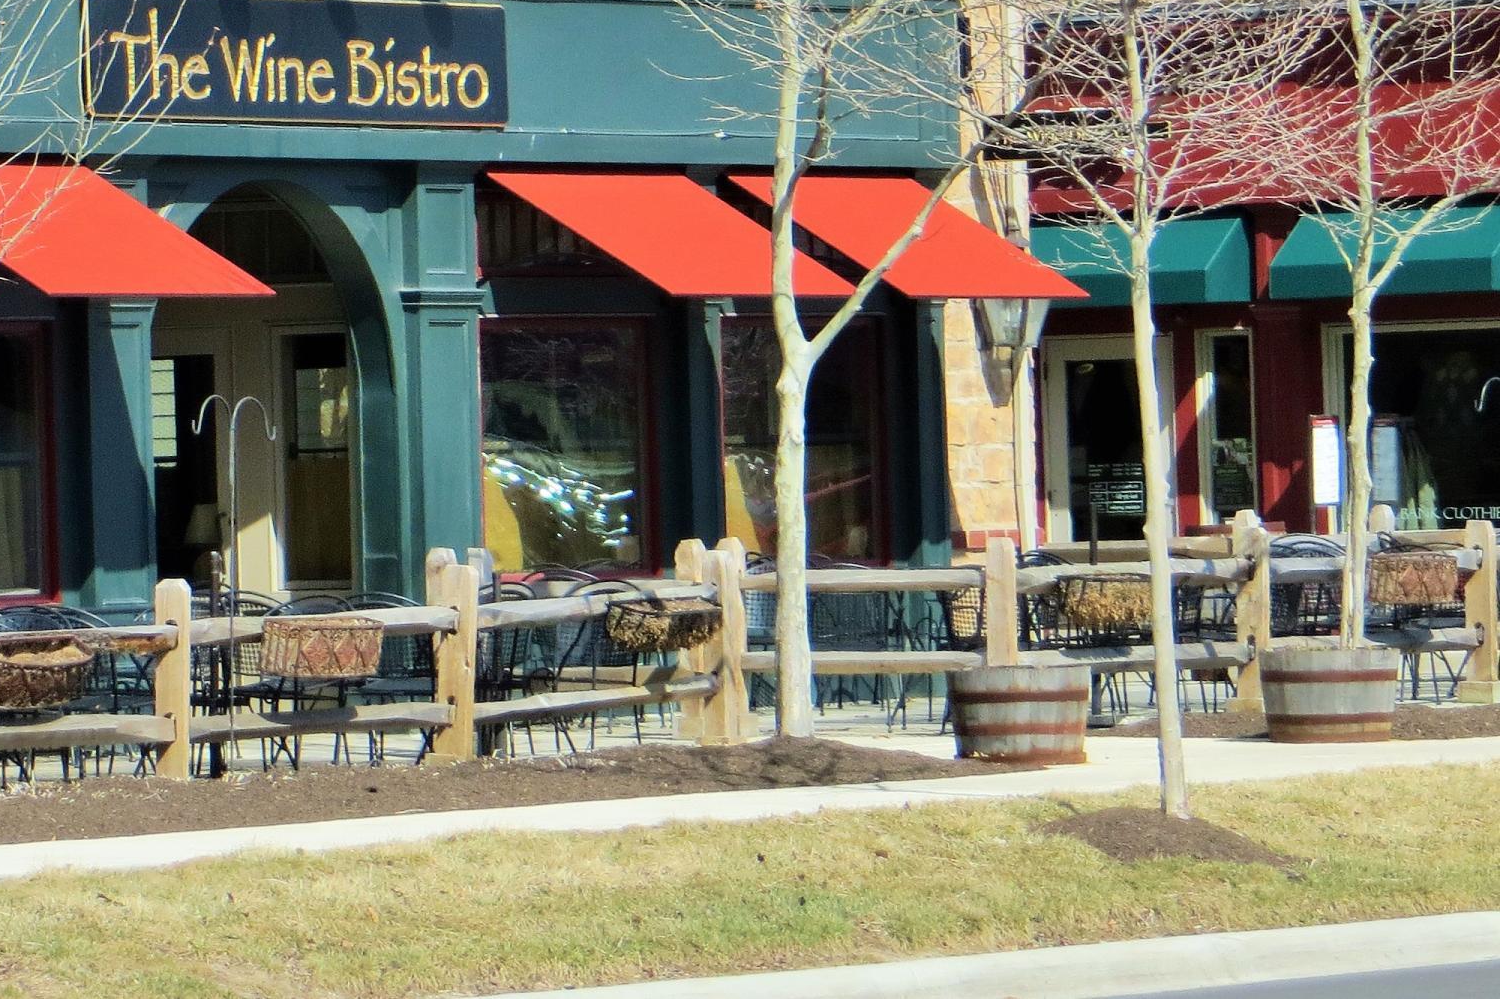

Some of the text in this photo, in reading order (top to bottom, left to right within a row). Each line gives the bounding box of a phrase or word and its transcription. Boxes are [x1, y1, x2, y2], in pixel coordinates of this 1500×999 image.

[109, 7, 490, 109] The Wine Bistro
